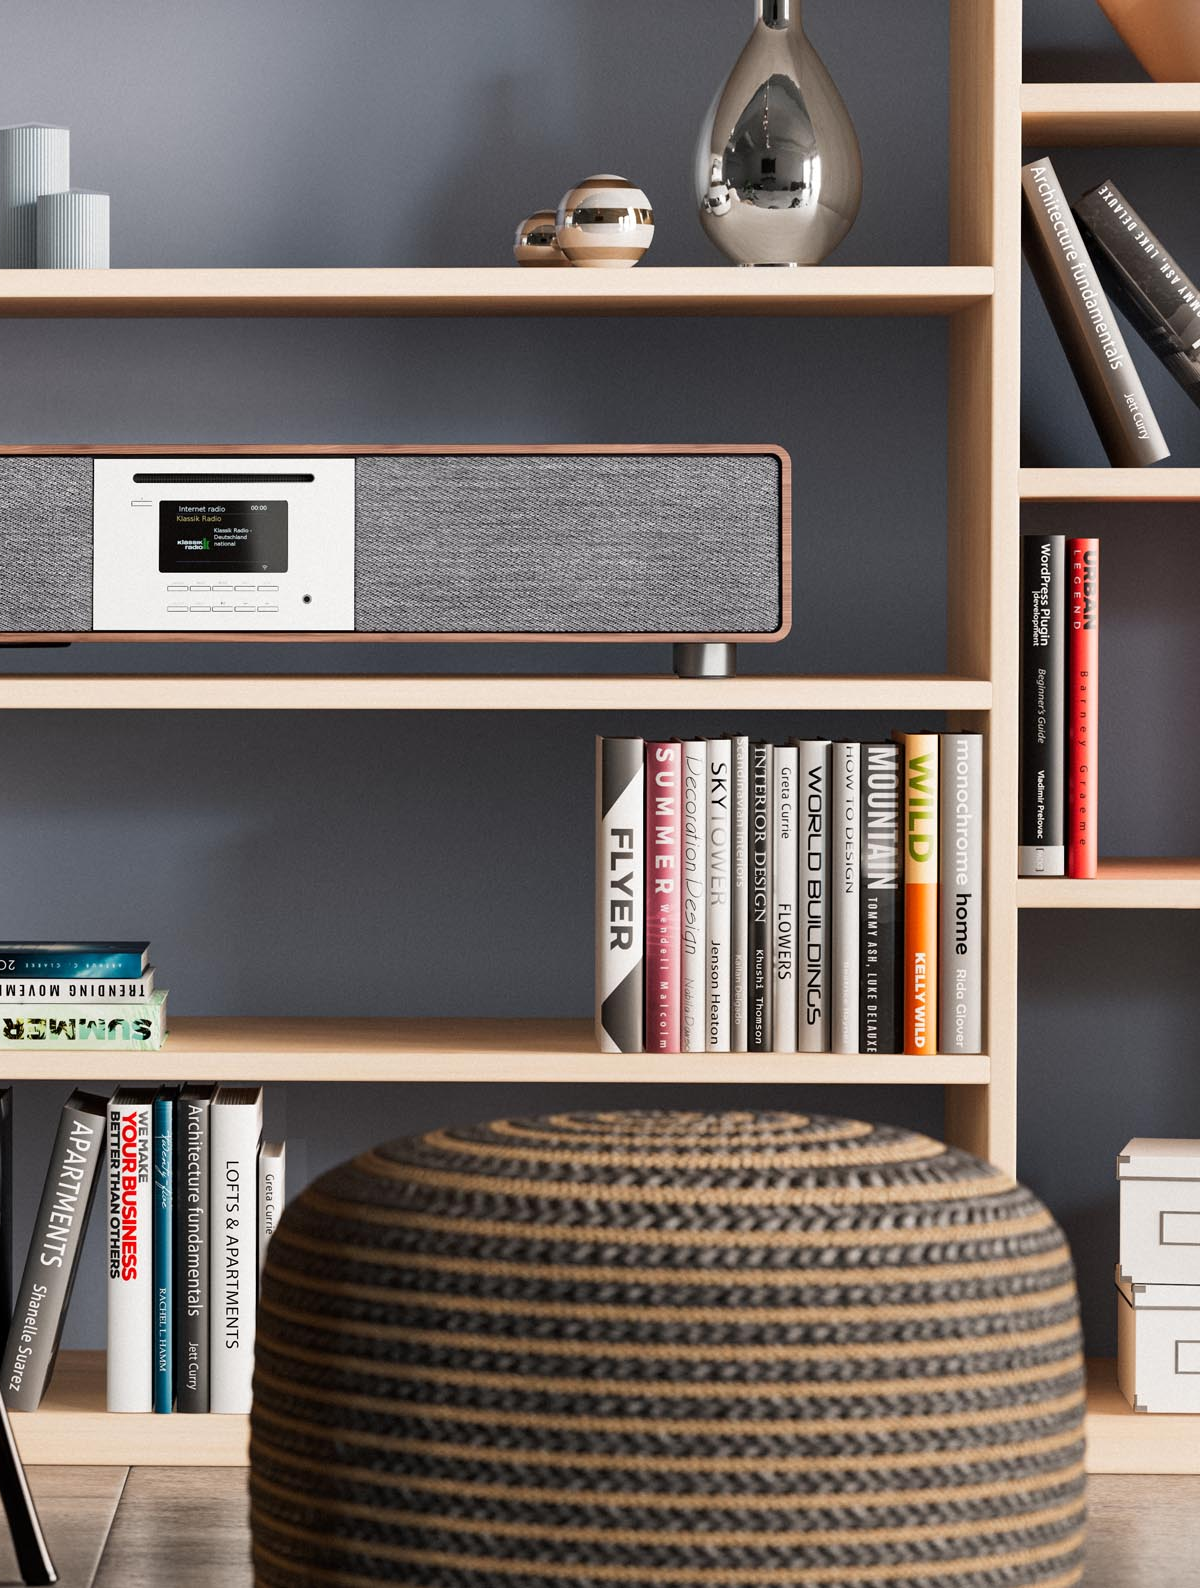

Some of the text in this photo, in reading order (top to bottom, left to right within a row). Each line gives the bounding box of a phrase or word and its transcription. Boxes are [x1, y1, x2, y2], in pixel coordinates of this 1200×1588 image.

[1098, 185, 1138, 232] DELAUXE
[1134, 232, 1160, 260] LUKE
[1030, 166, 1124, 370] Architecture fundamentals
[1124, 393, 1150, 440] Jett Curry
[179, 505, 226, 513] Internet radio
[1037, 544, 1051, 646] WordPress Plugin
[1073, 549, 1081, 630] LEGEND
[1083, 550, 1097, 630] URBAN
[1036, 668, 1047, 744] Beginner's Guide
[1036, 769, 1045, 804] Vladimir
[1079, 671, 1089, 846] Barney Graeme
[781, 767, 792, 839] Greta Currie
[845, 746, 855, 894] HOW TO DESIGN
[1036, 805, 1045, 839] Prelovac
[610, 828, 634, 951] FLYER
[682, 755, 704, 955] Decoration Design
[955, 739, 973, 1048] monochrome home Rida Glover
[655, 747, 675, 1048] SUMMER Wendell Malcolm
[754, 747, 767, 1044] INTERIOR DESIGN Khushi Thomson
[807, 766, 822, 1026] WORLD BUILDINGS
[866, 747, 899, 1053] MOUNTAIN TOMMY ASH, LUKE DELAUXE
[908, 753, 934, 1048] WILD KELLY WILD
[710, 939, 720, 989] Jenson
[778, 903, 792, 980] FLOWERS
[2, 1018, 153, 1041] SUMMER
[69, 984, 145, 997] TRENDING
[710, 994, 721, 1045] Heaton
[138, 1110, 149, 1184] WE MAKE
[109, 1111, 121, 1280] BETTER THAN OTHERS
[121, 1111, 138, 1282] YOUR BUSINESS
[187, 1104, 204, 1317] Architecture fundamentals
[265, 1173, 275, 1235] Greta Currie
[9, 1120, 94, 1392] APARTMENTS Shanelle Suarez
[225, 1161, 240, 1349] LOFTS & APARTMENTS
[159, 1287, 167, 1327] RACHEL
[159, 1340, 167, 1372] HAMM
[186, 1341, 199, 1391] Jett Curry
